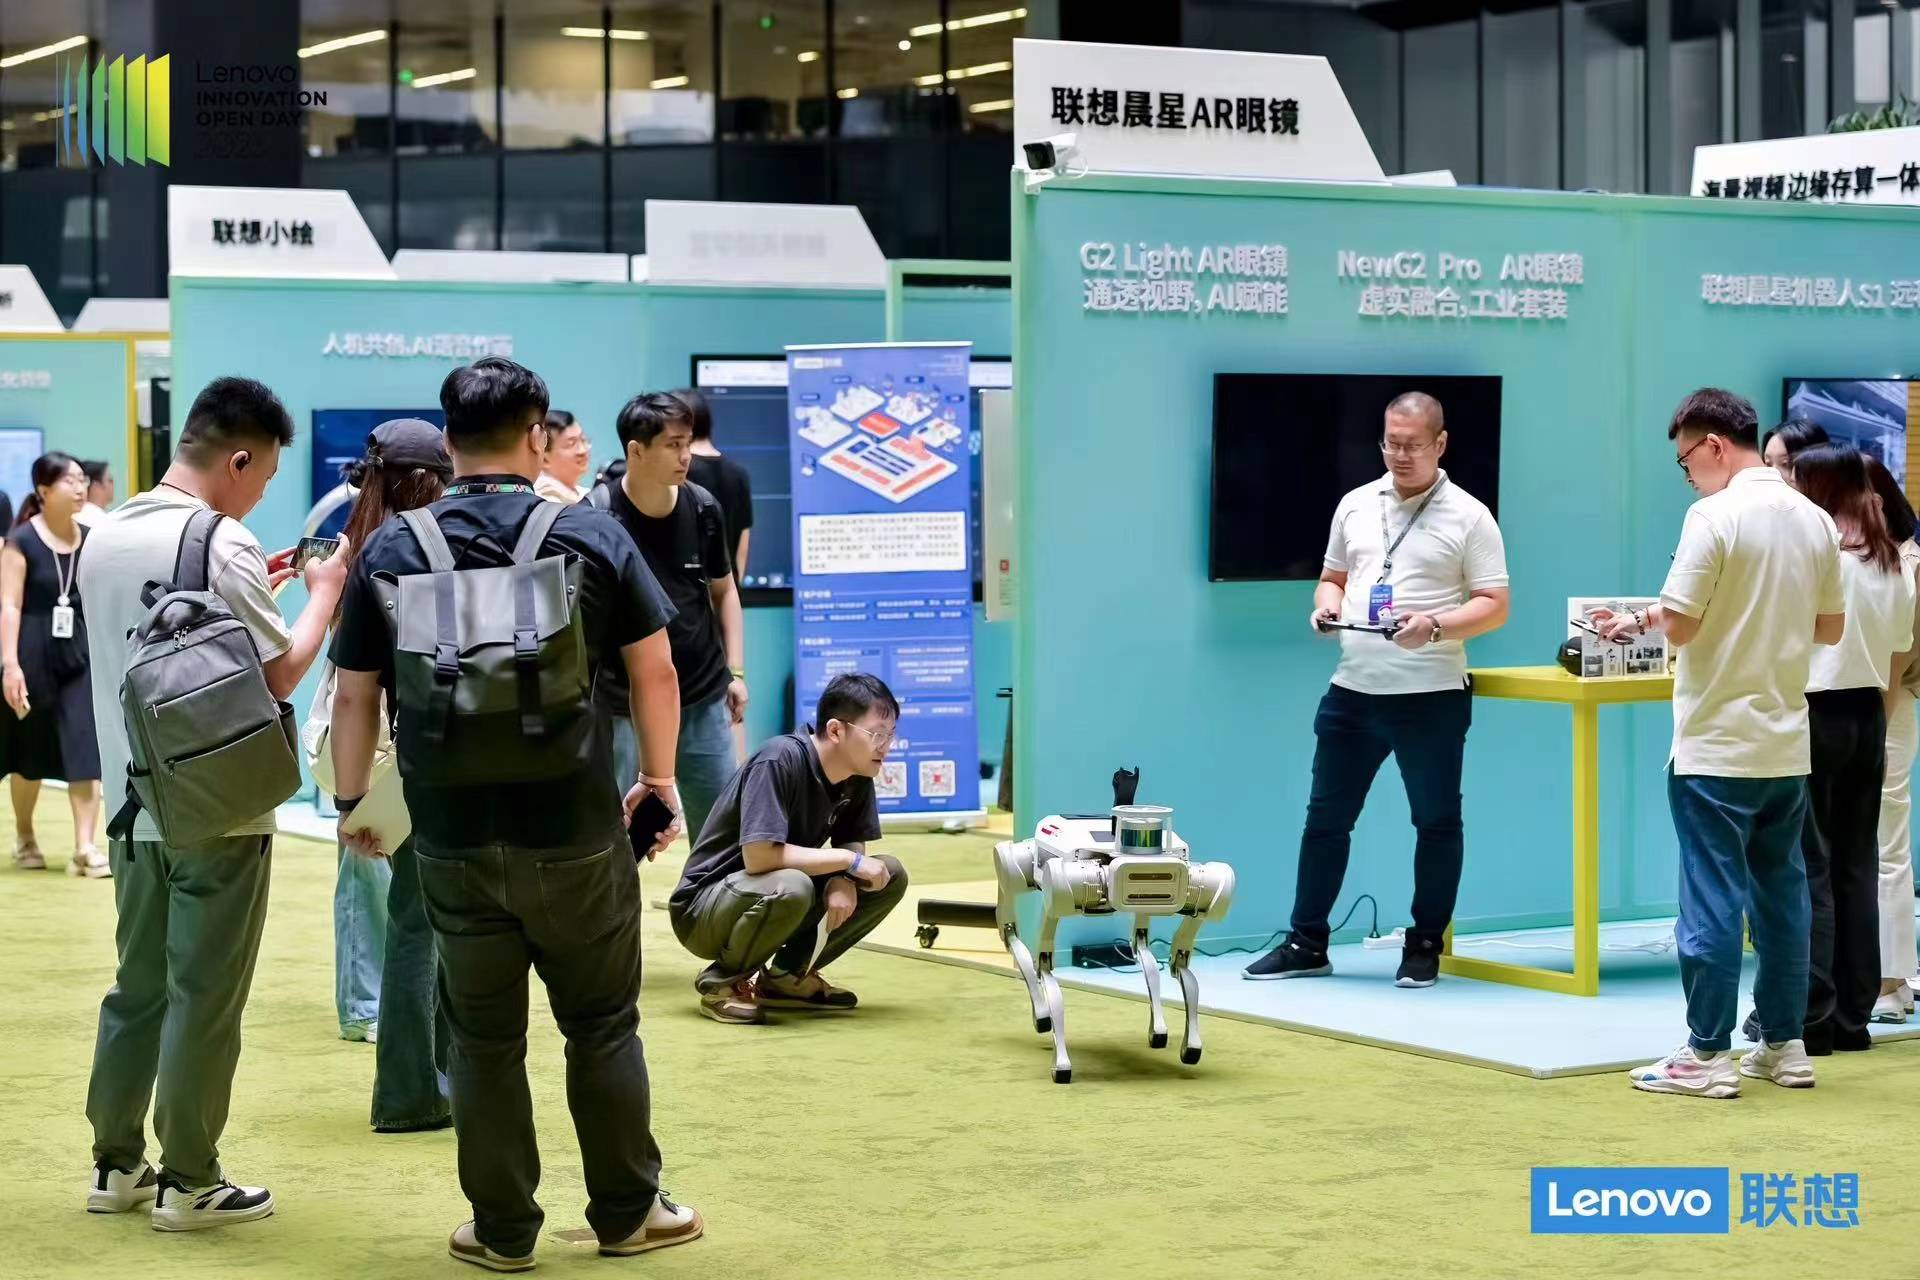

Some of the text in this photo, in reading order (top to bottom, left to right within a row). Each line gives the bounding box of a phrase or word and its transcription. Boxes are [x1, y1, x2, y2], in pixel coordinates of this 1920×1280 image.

[1051, 86, 1300, 135] 联想晨星AR眼镜
[212, 219, 313, 245] 联想小绘
[1080, 242, 1289, 280] G2 Light AR眼镜
[1338, 250, 1584, 285] NewG2 Pro AR眼镜
[1358, 285, 1569, 319] 虚实融合,工业套装
[1701, 274, 1885, 308] 联想晨星机器人S1
